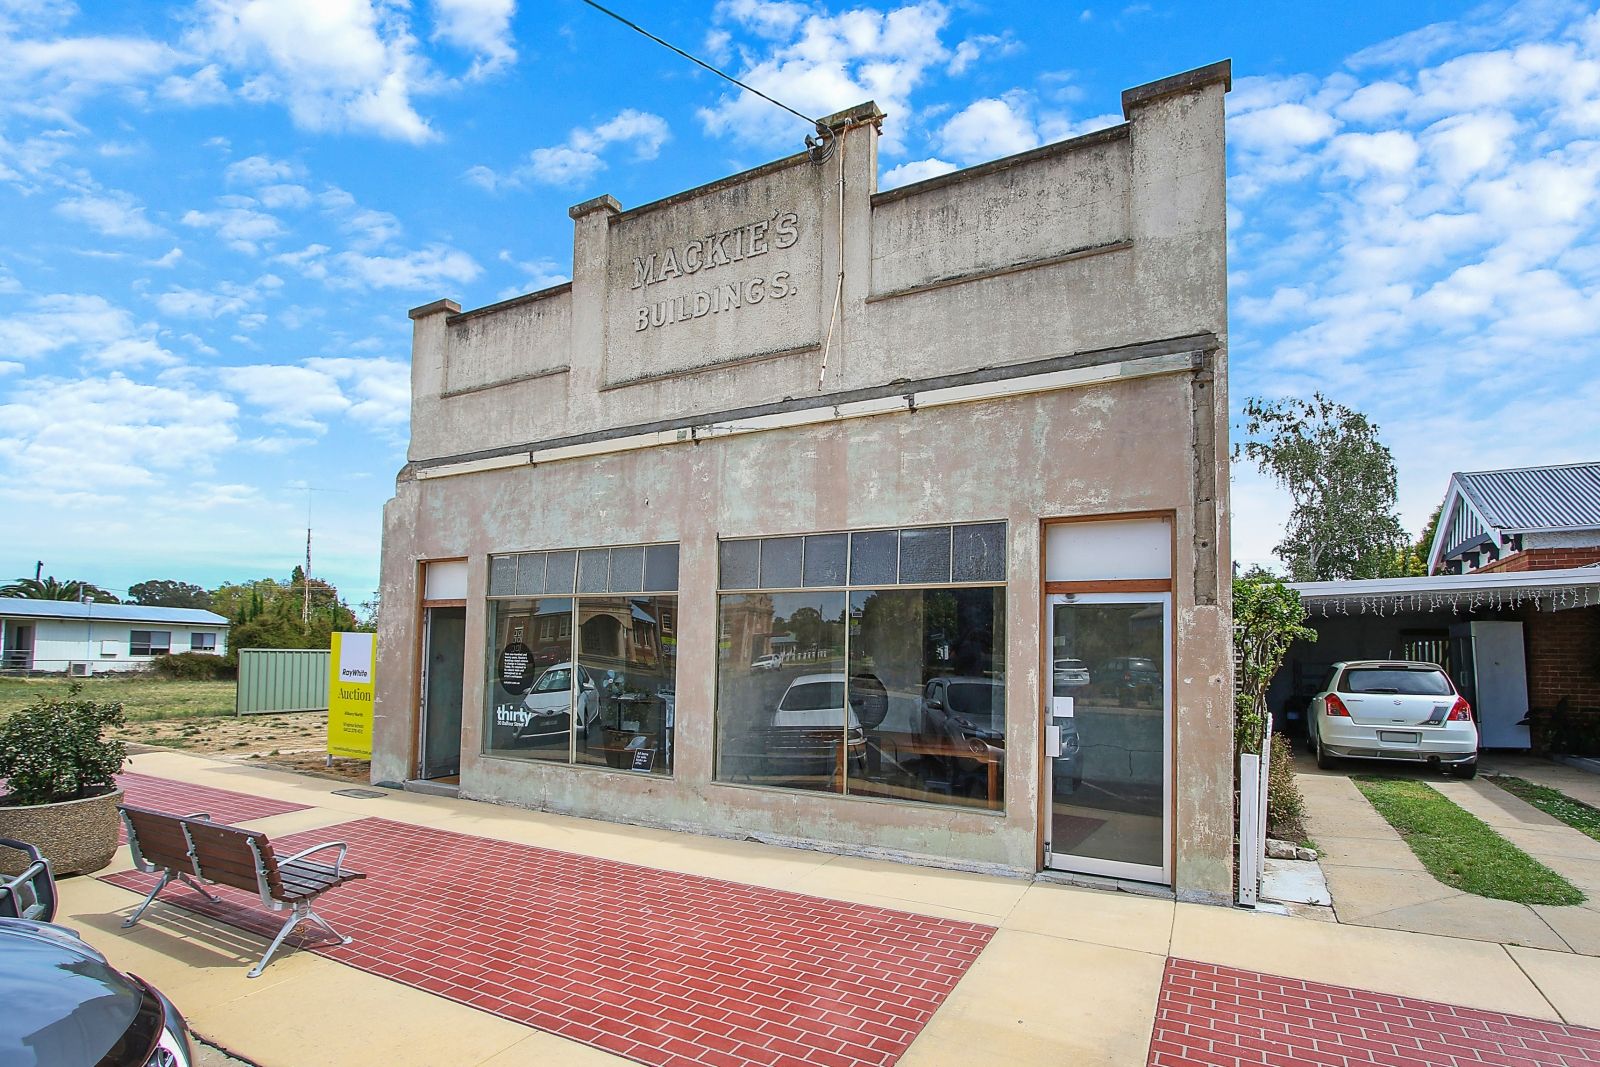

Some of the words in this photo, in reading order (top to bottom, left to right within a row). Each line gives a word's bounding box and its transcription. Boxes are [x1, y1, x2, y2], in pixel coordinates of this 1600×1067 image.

[631, 209, 799, 290] MACKIE'S
[635, 271, 798, 332] BUILDINGS.
[337, 688, 371, 702] Auction
[496, 704, 532, 727] thirty
